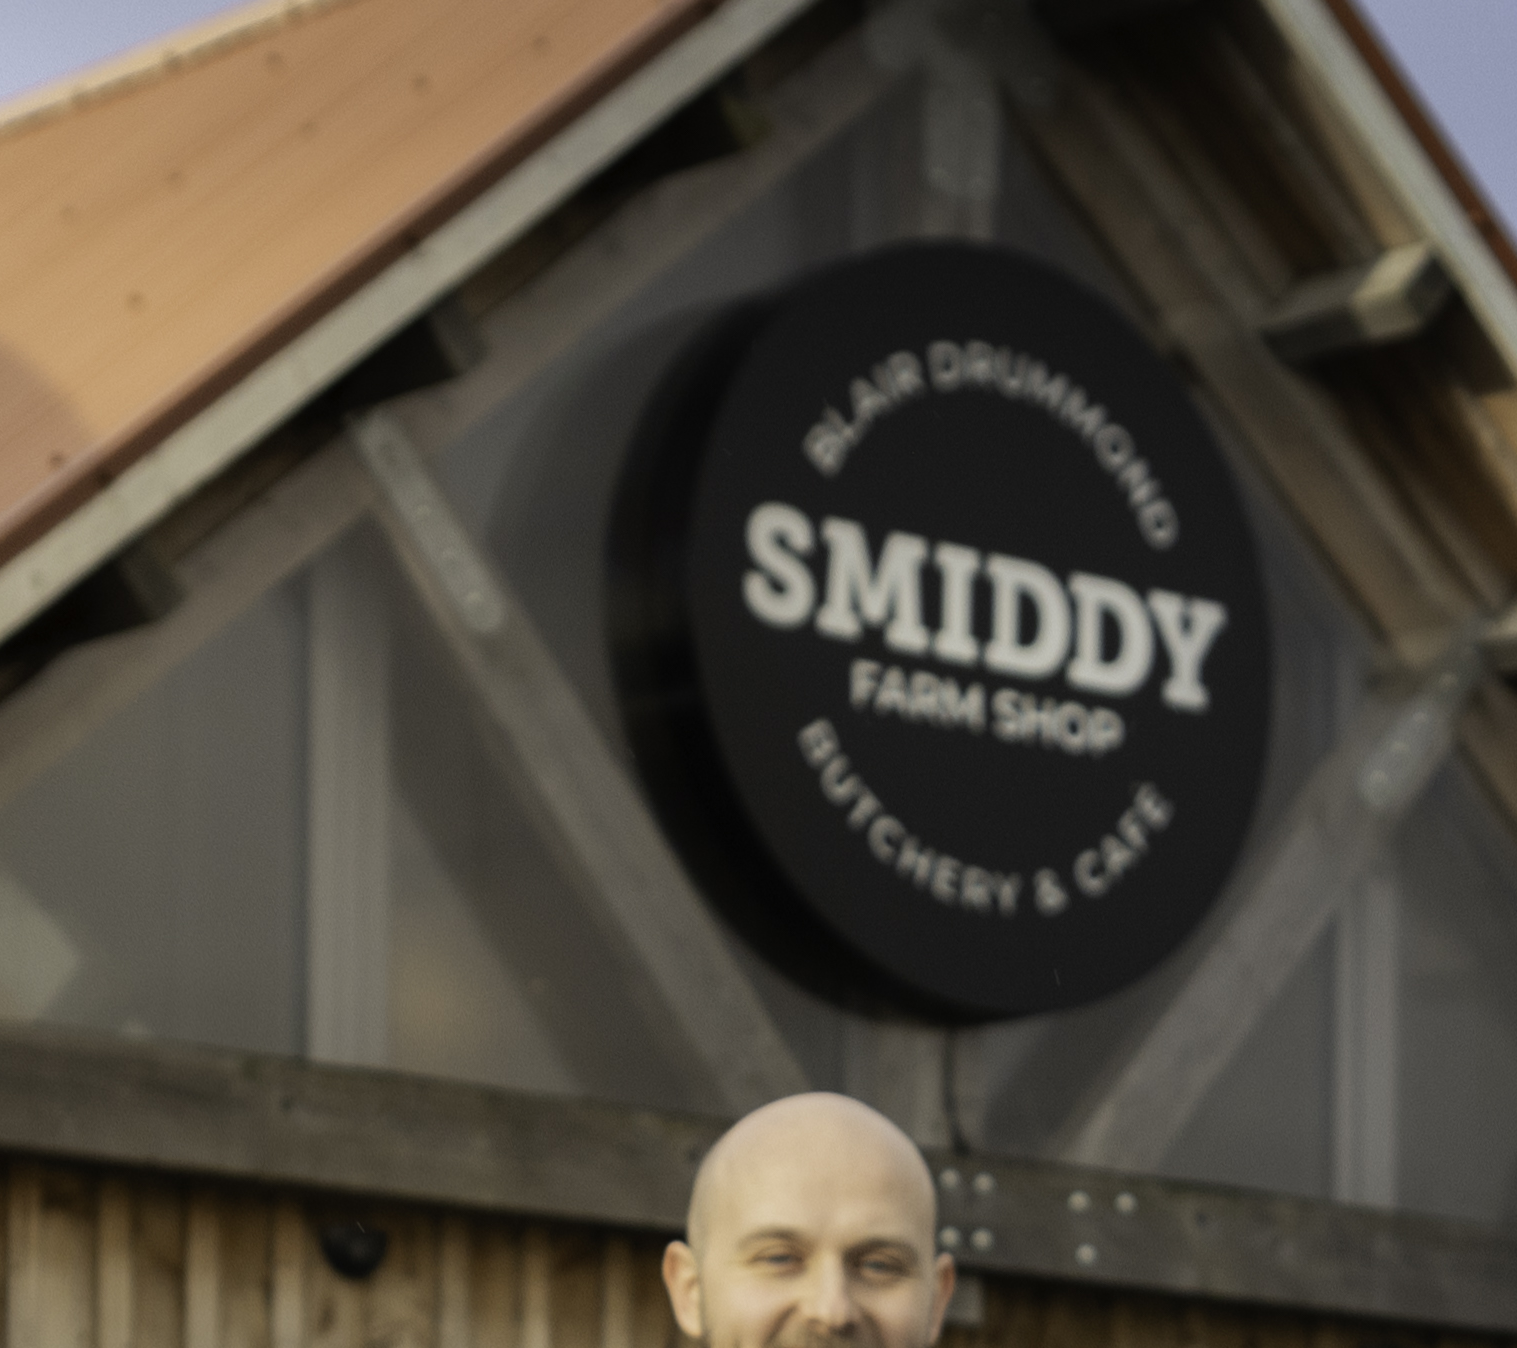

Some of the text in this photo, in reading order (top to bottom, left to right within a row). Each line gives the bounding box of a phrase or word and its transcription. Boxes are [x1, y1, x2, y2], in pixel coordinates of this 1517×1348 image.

[803, 341, 1178, 549] BLAIR DRUMMOND
[743, 502, 1227, 713] SMIDDY
[850, 659, 1125, 755] FARM SHOP
[797, 718, 1022, 916] BUTCHERY
[1033, 866, 1068, 917] &
